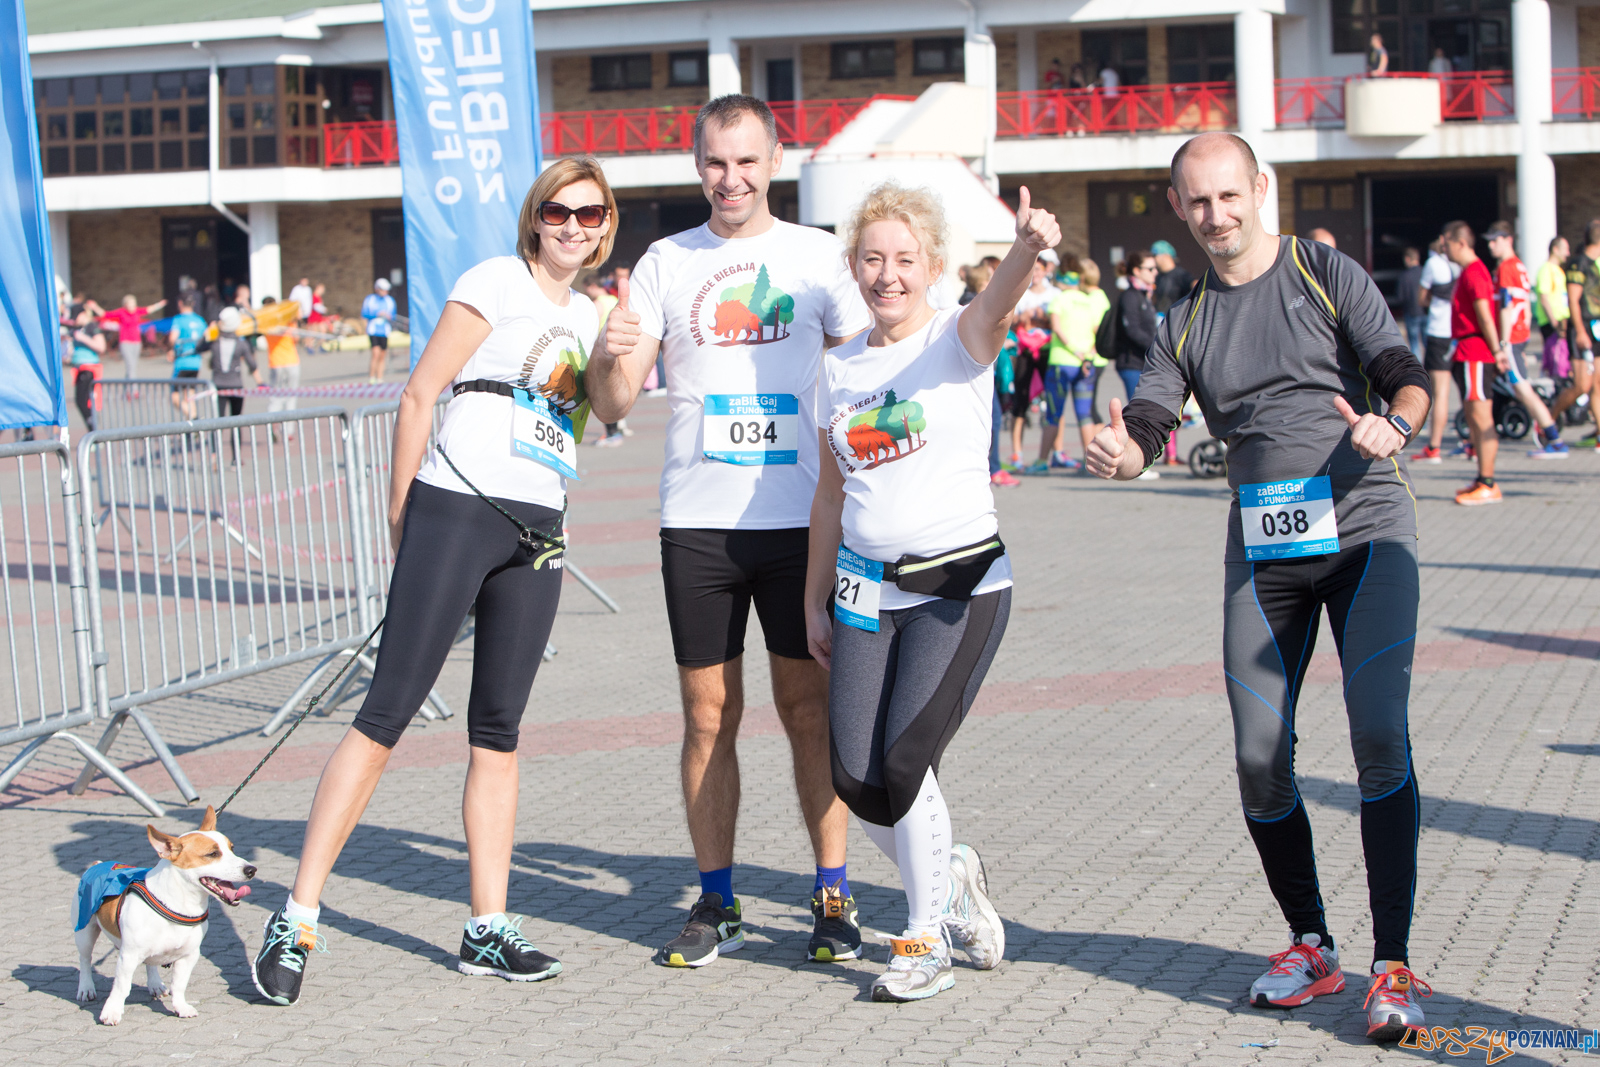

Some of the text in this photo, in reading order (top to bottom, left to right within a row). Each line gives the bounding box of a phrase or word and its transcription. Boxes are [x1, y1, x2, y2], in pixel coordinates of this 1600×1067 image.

[689, 262, 756, 347] NARAMOWICE BIEGAJĄ
[729, 396, 777, 407] zaBIEGaj
[736, 406, 777, 414] FUNdusze
[534, 420, 564, 453] 598
[729, 421, 777, 444] 034
[1257, 481, 1305, 496] zaBIEGaj
[1264, 494, 1305, 505] FUNdusze
[1262, 509, 1309, 537] 038
[905, 942, 927, 954] 021
